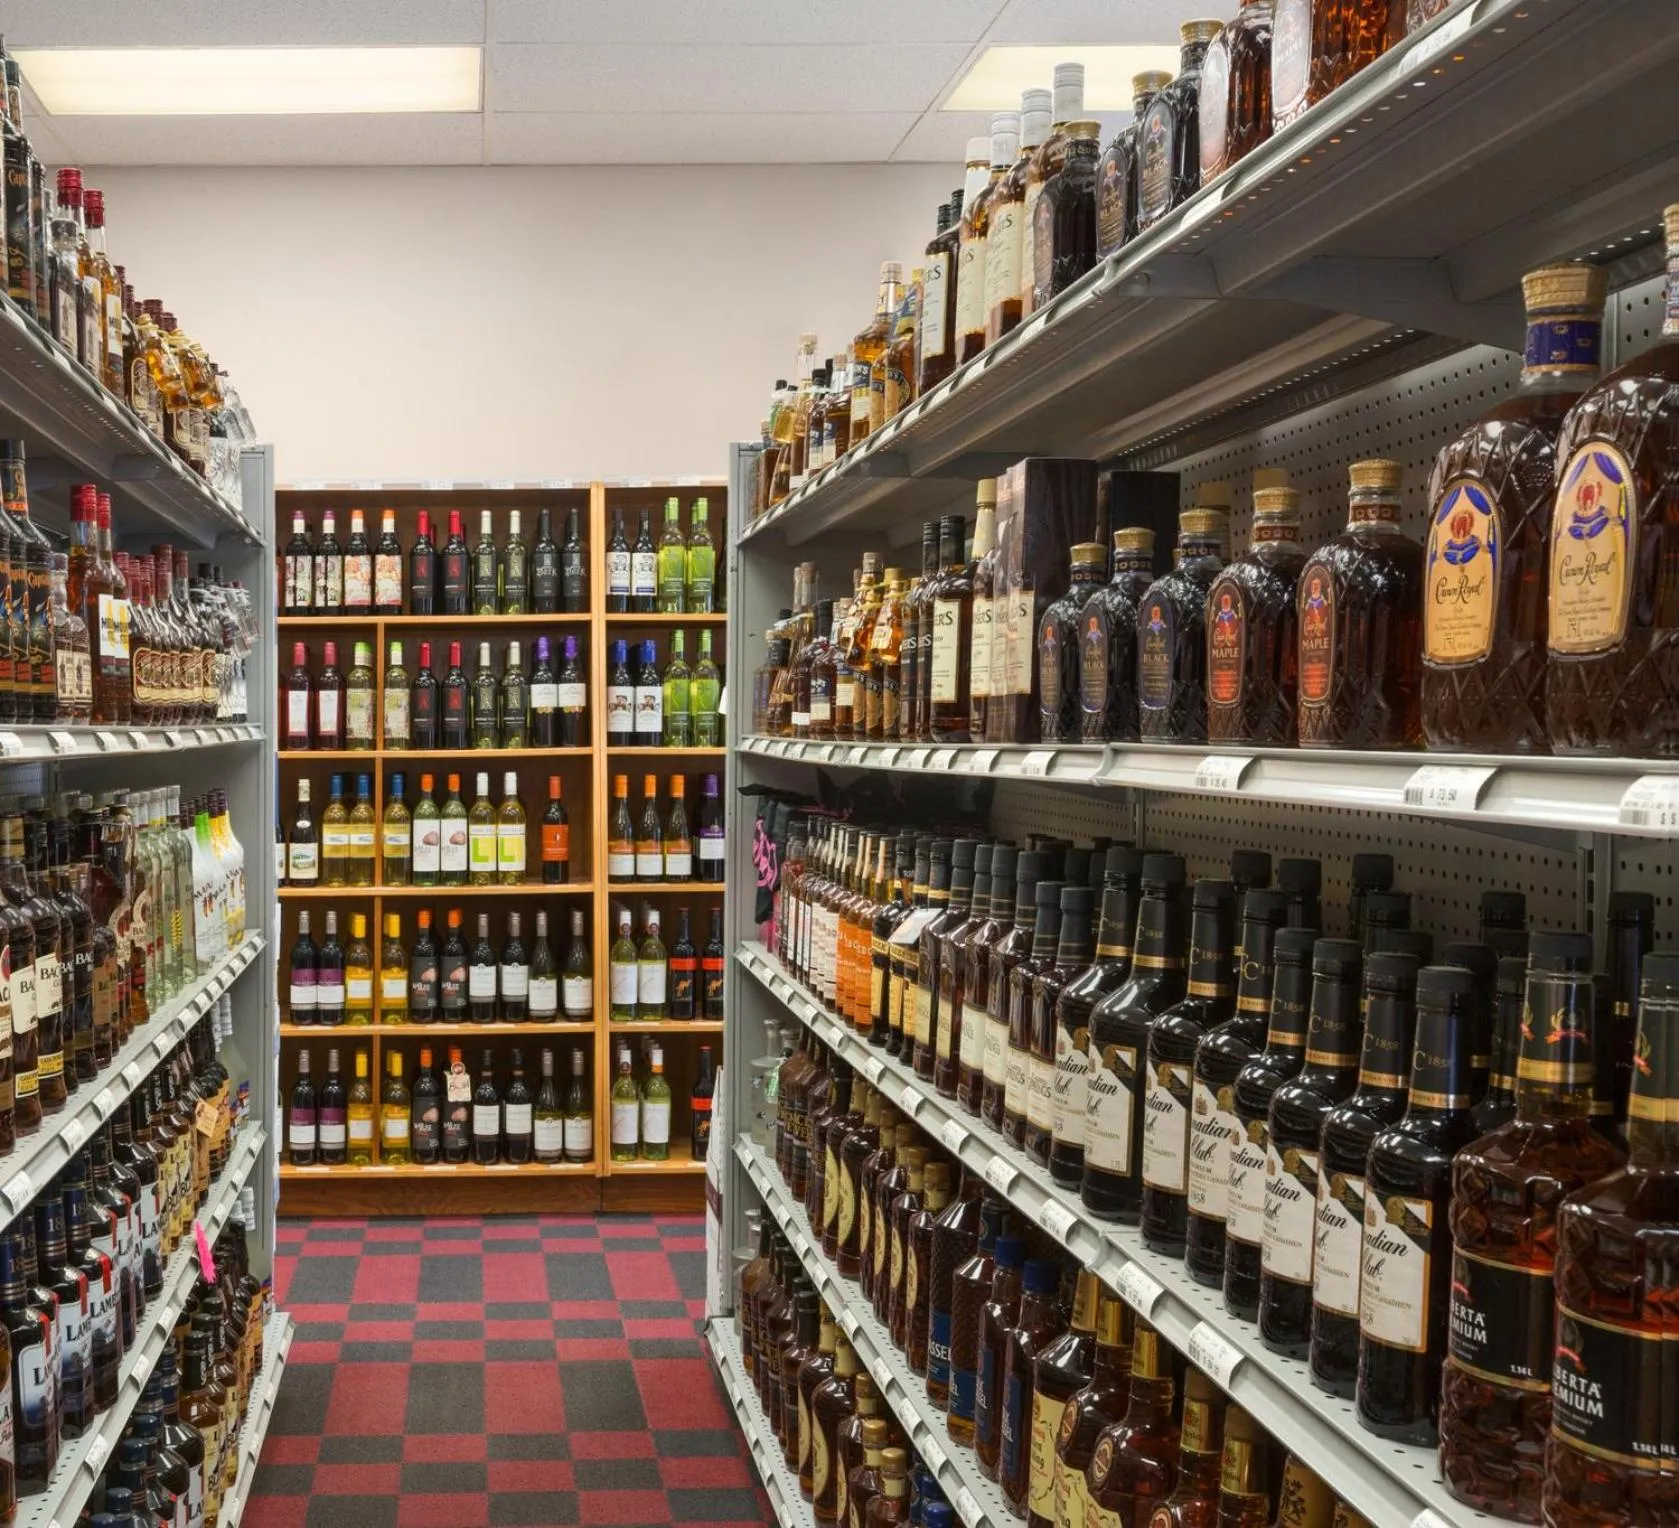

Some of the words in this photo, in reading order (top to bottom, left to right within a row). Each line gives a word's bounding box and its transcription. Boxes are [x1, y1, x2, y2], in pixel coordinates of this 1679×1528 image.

[1559, 555, 1584, 586] Crown
[1576, 551, 1615, 586] Royal
[1436, 578, 1459, 605] Crown
[1452, 574, 1483, 605] Royal
[1212, 647, 1239, 659] MAPLE
[1302, 637, 1329, 650] MAPLE
